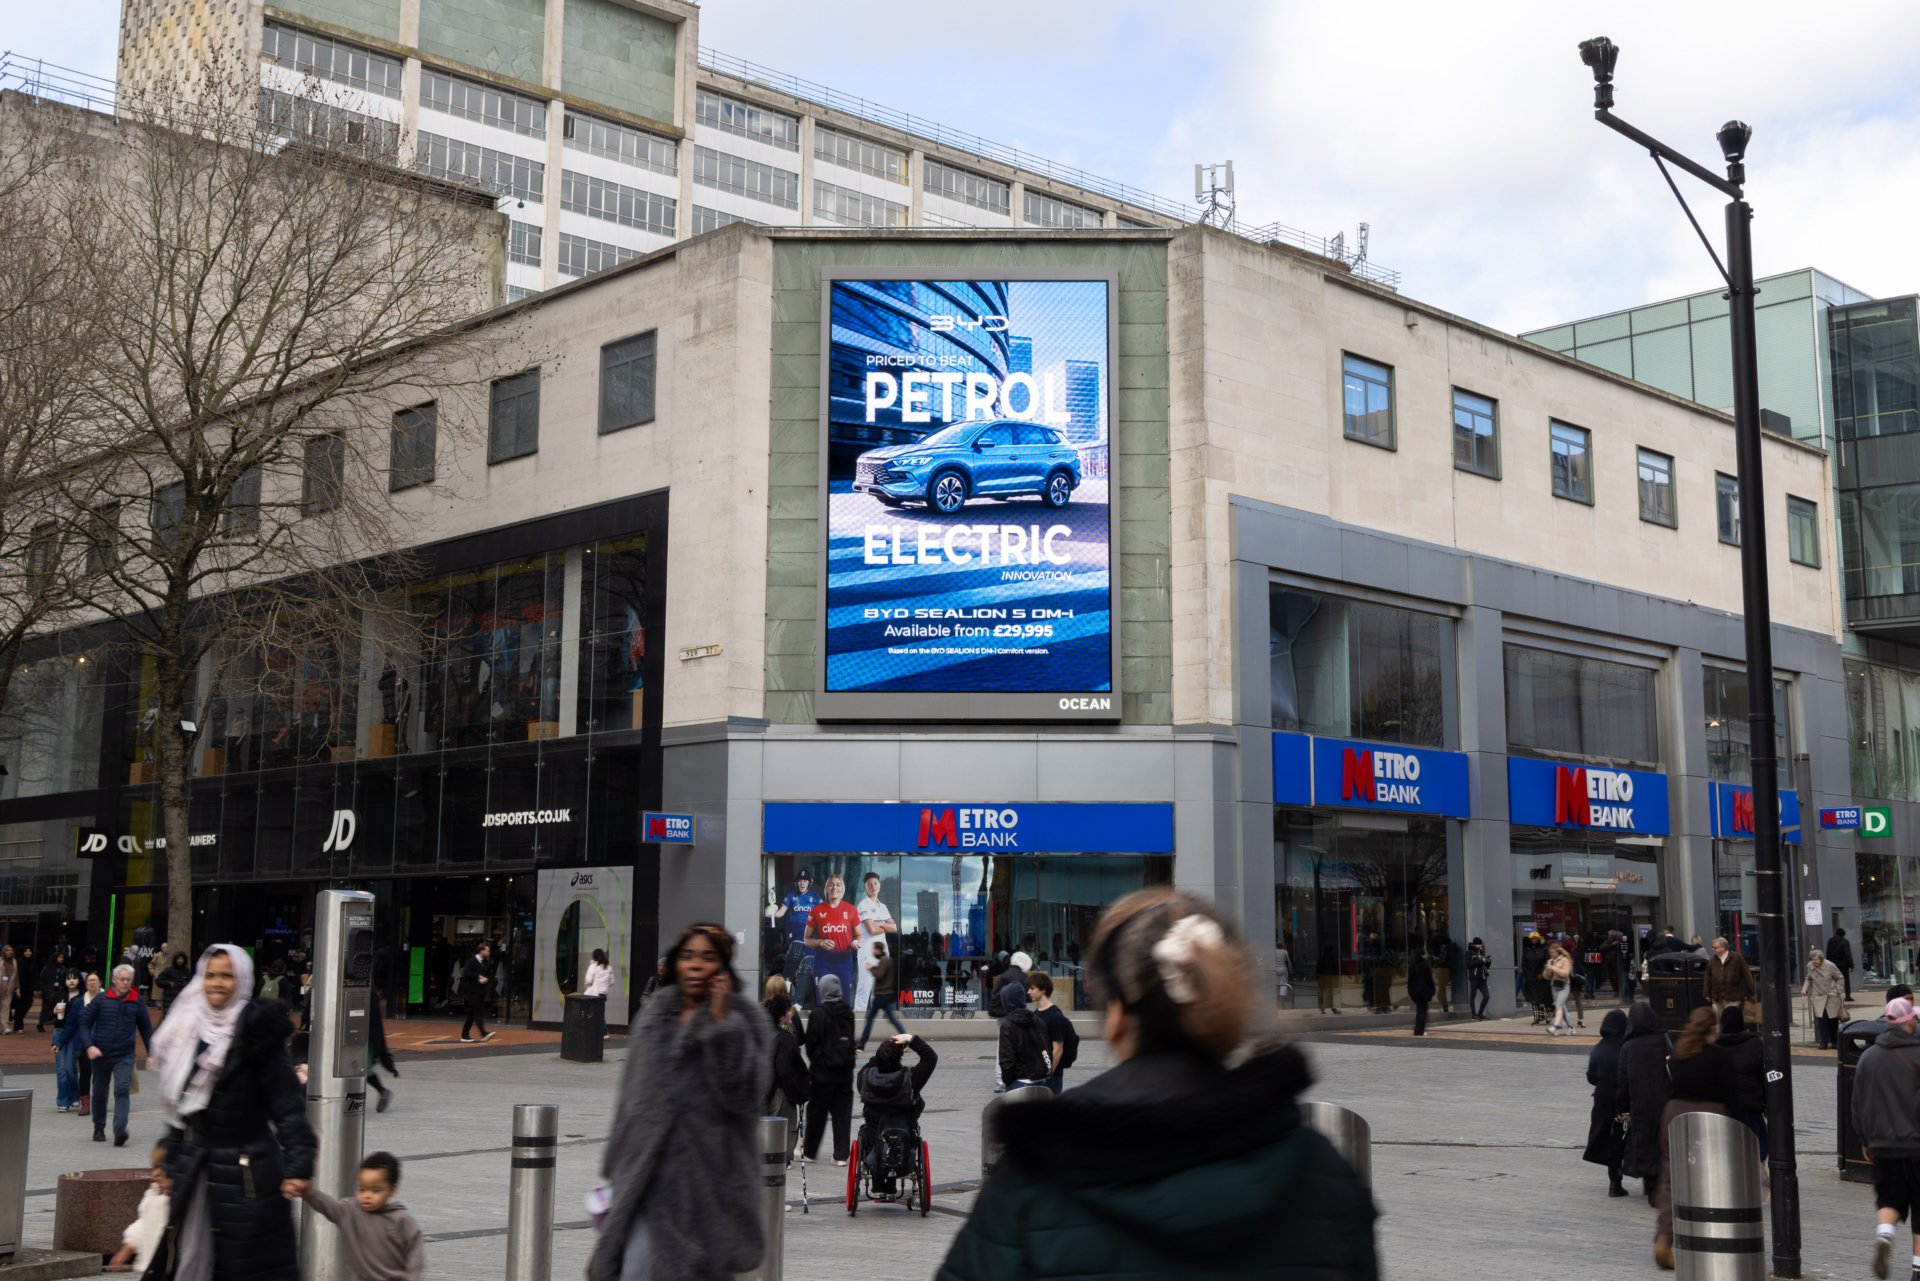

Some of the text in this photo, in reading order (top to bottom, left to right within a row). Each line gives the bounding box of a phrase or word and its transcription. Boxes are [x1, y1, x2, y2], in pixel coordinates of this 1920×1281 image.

[930, 315, 1009, 332] BYD
[866, 355, 975, 366] PRICED TO BEAT
[865, 371, 1072, 423] PETROL
[864, 524, 1073, 565] ELECTRIC
[864, 608, 909, 618] BYD
[914, 608, 1007, 618] SEALION
[1012, 608, 1026, 618] 5
[884, 623, 1054, 639] Available from £29,995
[997, 647, 1024, 655] Comfort
[1059, 698, 1111, 710] OCEAN
[1342, 748, 1420, 801] METRO
[1377, 783, 1421, 805] BANK
[1555, 765, 1634, 825] METRO
[482, 808, 571, 828] JDSPORTS.CO.UK
[1590, 805, 1635, 829] BANK
[1822, 810, 1858, 825] METRO
[1836, 818, 1858, 826] BANK
[1865, 811, 1887, 833] D
[322, 809, 356, 853] JD
[649, 817, 690, 837] METRO
[666, 830, 690, 839] BANK
[917, 808, 1019, 848] METRO
[80, 833, 108, 852] JD
[962, 832, 1019, 847] BANK
[822, 922, 848, 933] cinch
[899, 990, 934, 1004] METRO
